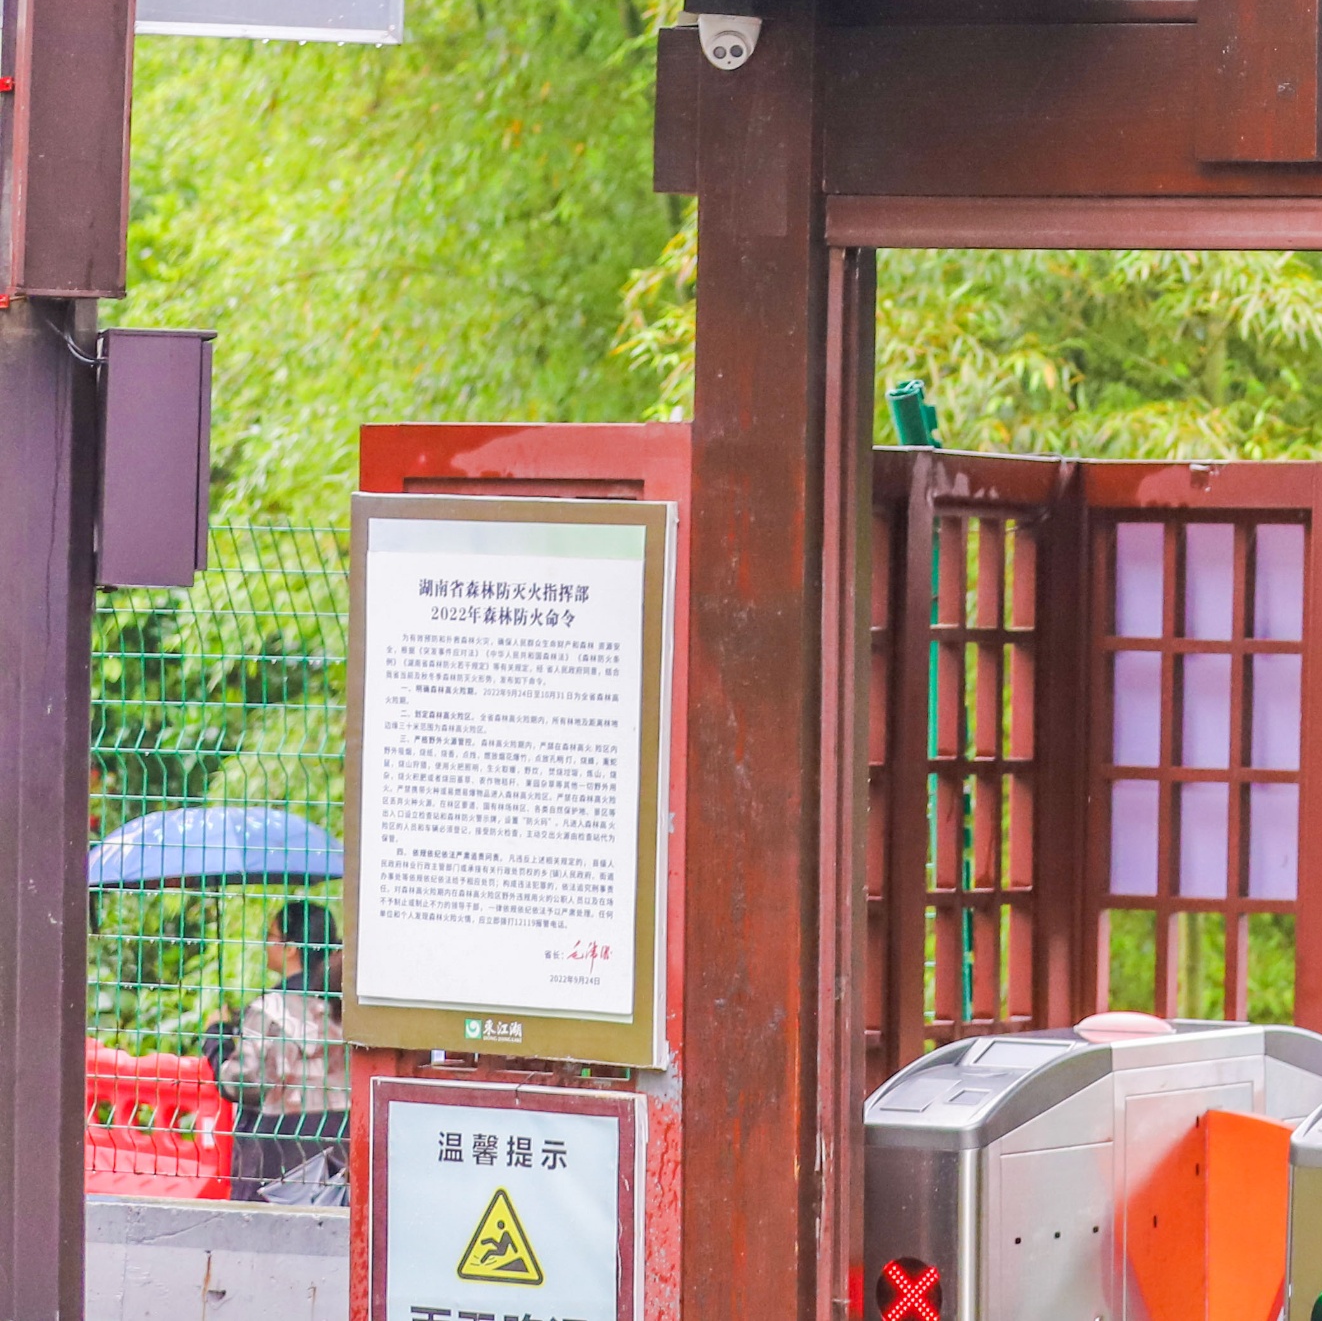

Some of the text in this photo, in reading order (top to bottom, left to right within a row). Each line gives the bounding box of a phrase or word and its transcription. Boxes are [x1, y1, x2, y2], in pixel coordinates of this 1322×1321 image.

[418, 578, 590, 604] 湖南省森林防灭火指挥部
[431, 605, 576, 628] 2022年森林防火命令
[550, 975, 601, 986] 2022年9月24日
[438, 1131, 568, 1170] 温馨提示
